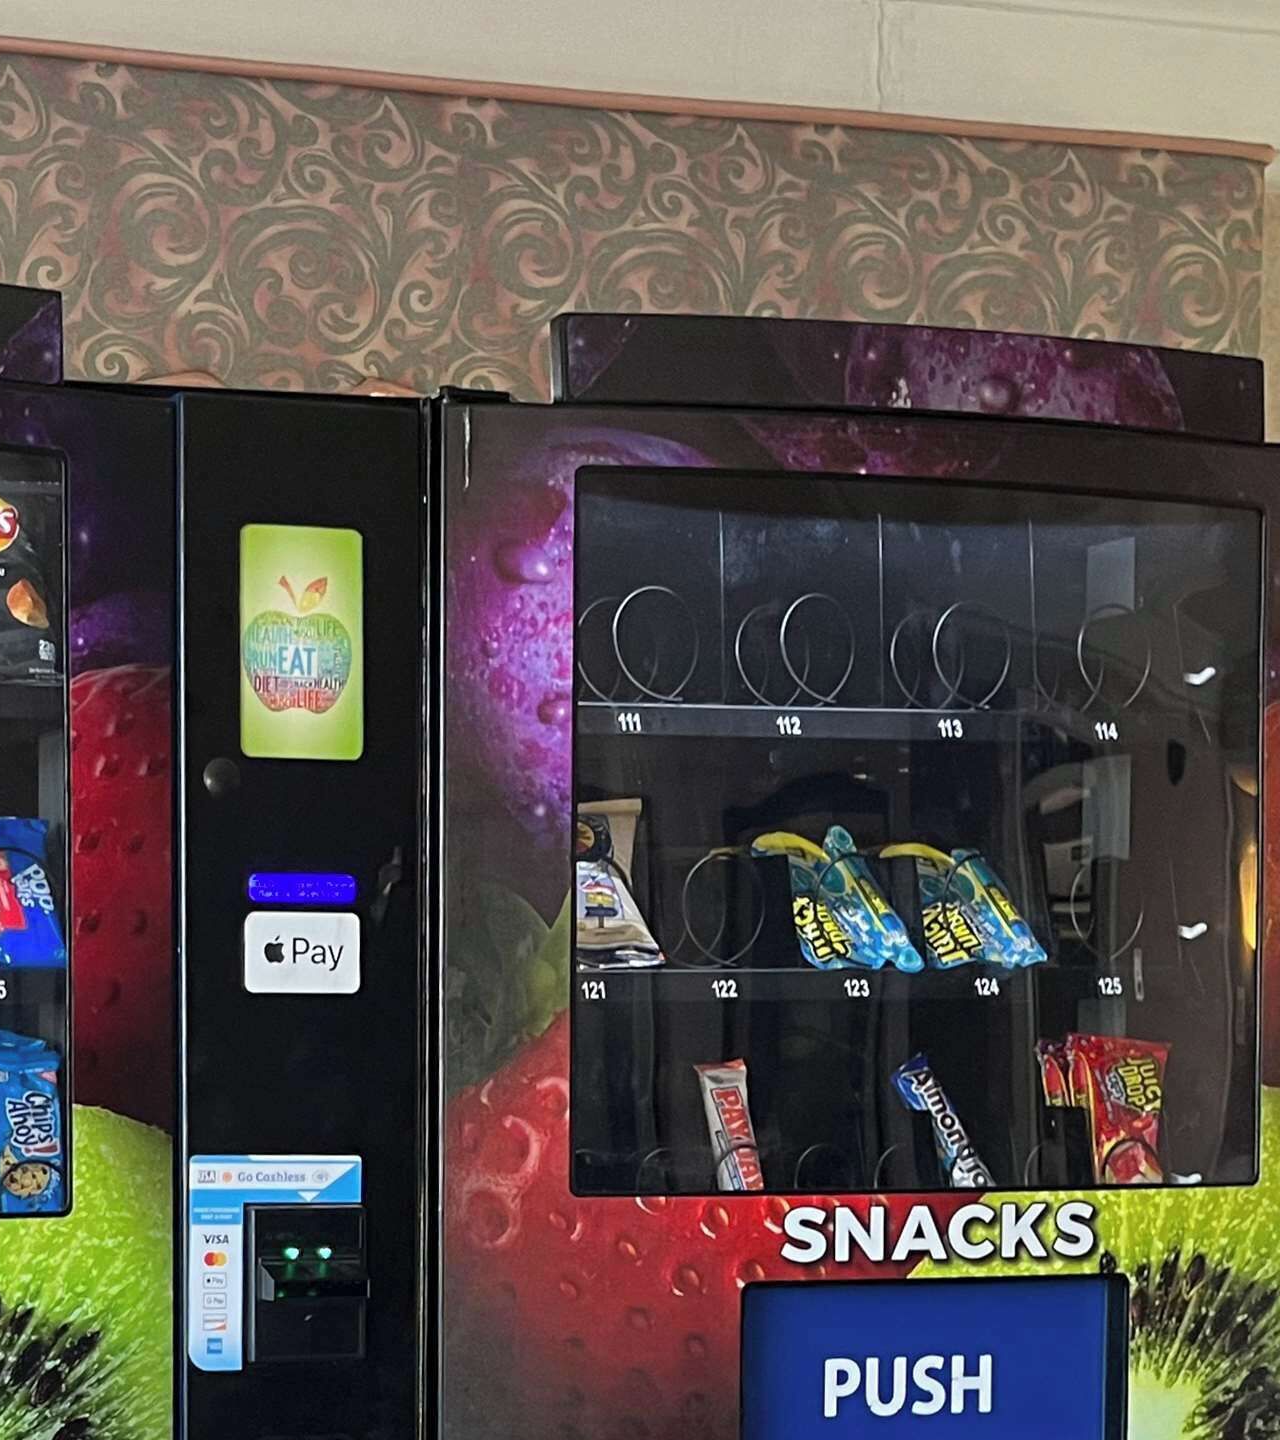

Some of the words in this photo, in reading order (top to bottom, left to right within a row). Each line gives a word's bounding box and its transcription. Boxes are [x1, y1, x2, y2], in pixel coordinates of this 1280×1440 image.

[278, 646, 316, 676] EAT
[254, 676, 280, 693] DIET
[619, 713, 642, 731] 111
[777, 716, 802, 736] 112
[938, 719, 964, 738] 113
[1094, 721, 1118, 740] 114
[292, 938, 344, 971] Pay
[581, 980, 607, 999] 121
[712, 979, 738, 998] 122
[844, 978, 870, 997] 123
[975, 977, 999, 996] 124
[1098, 977, 1122, 996] 125
[1118, 1064, 1146, 1108] DROP
[1126, 1057, 1162, 1112] JUICY
[23, 1091, 56, 1145] Chips
[238, 1172, 254, 1183] Go
[256, 1170, 306, 1183] Cashless
[203, 1234, 230, 1244] VISA
[781, 1202, 1094, 1263] SNACKS
[824, 1353, 992, 1418] PUSH
